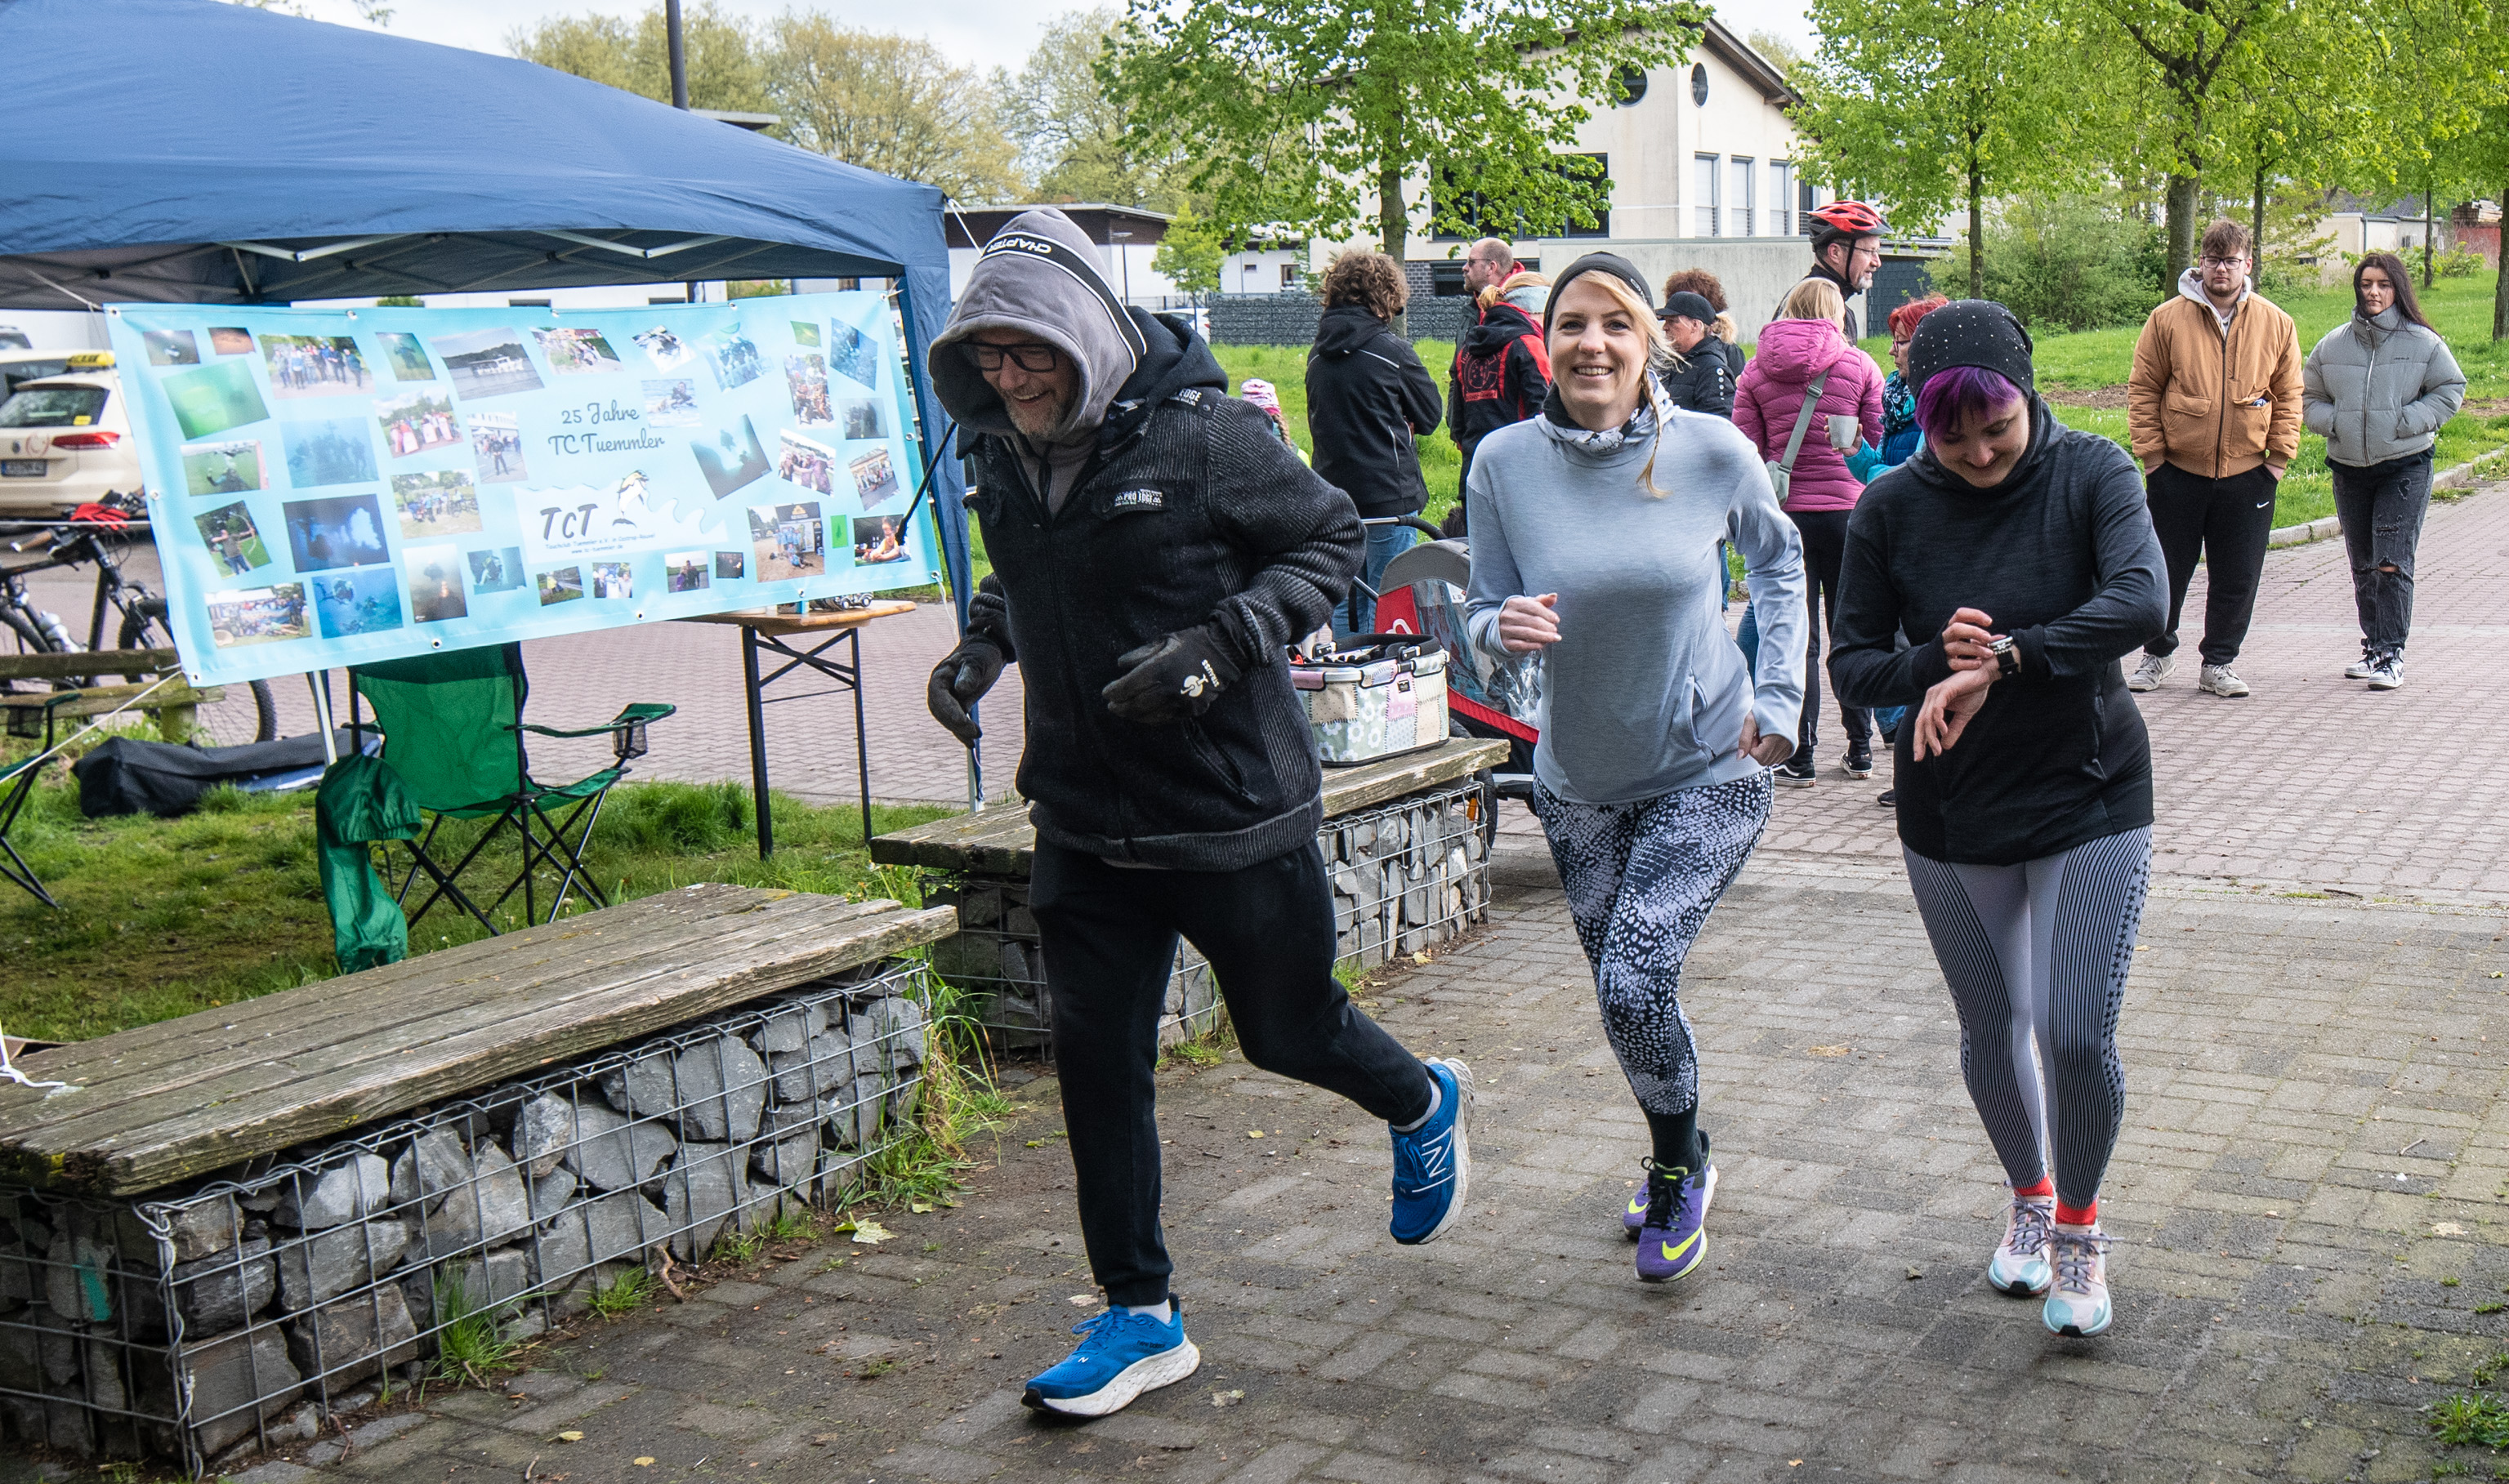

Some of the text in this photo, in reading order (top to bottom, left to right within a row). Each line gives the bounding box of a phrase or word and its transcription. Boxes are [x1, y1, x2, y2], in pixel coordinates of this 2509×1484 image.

[561, 399, 640, 425] 25 Jahre
[547, 428, 665, 456] TC Tuemmler
[1123, 491, 1137, 501] PRO
